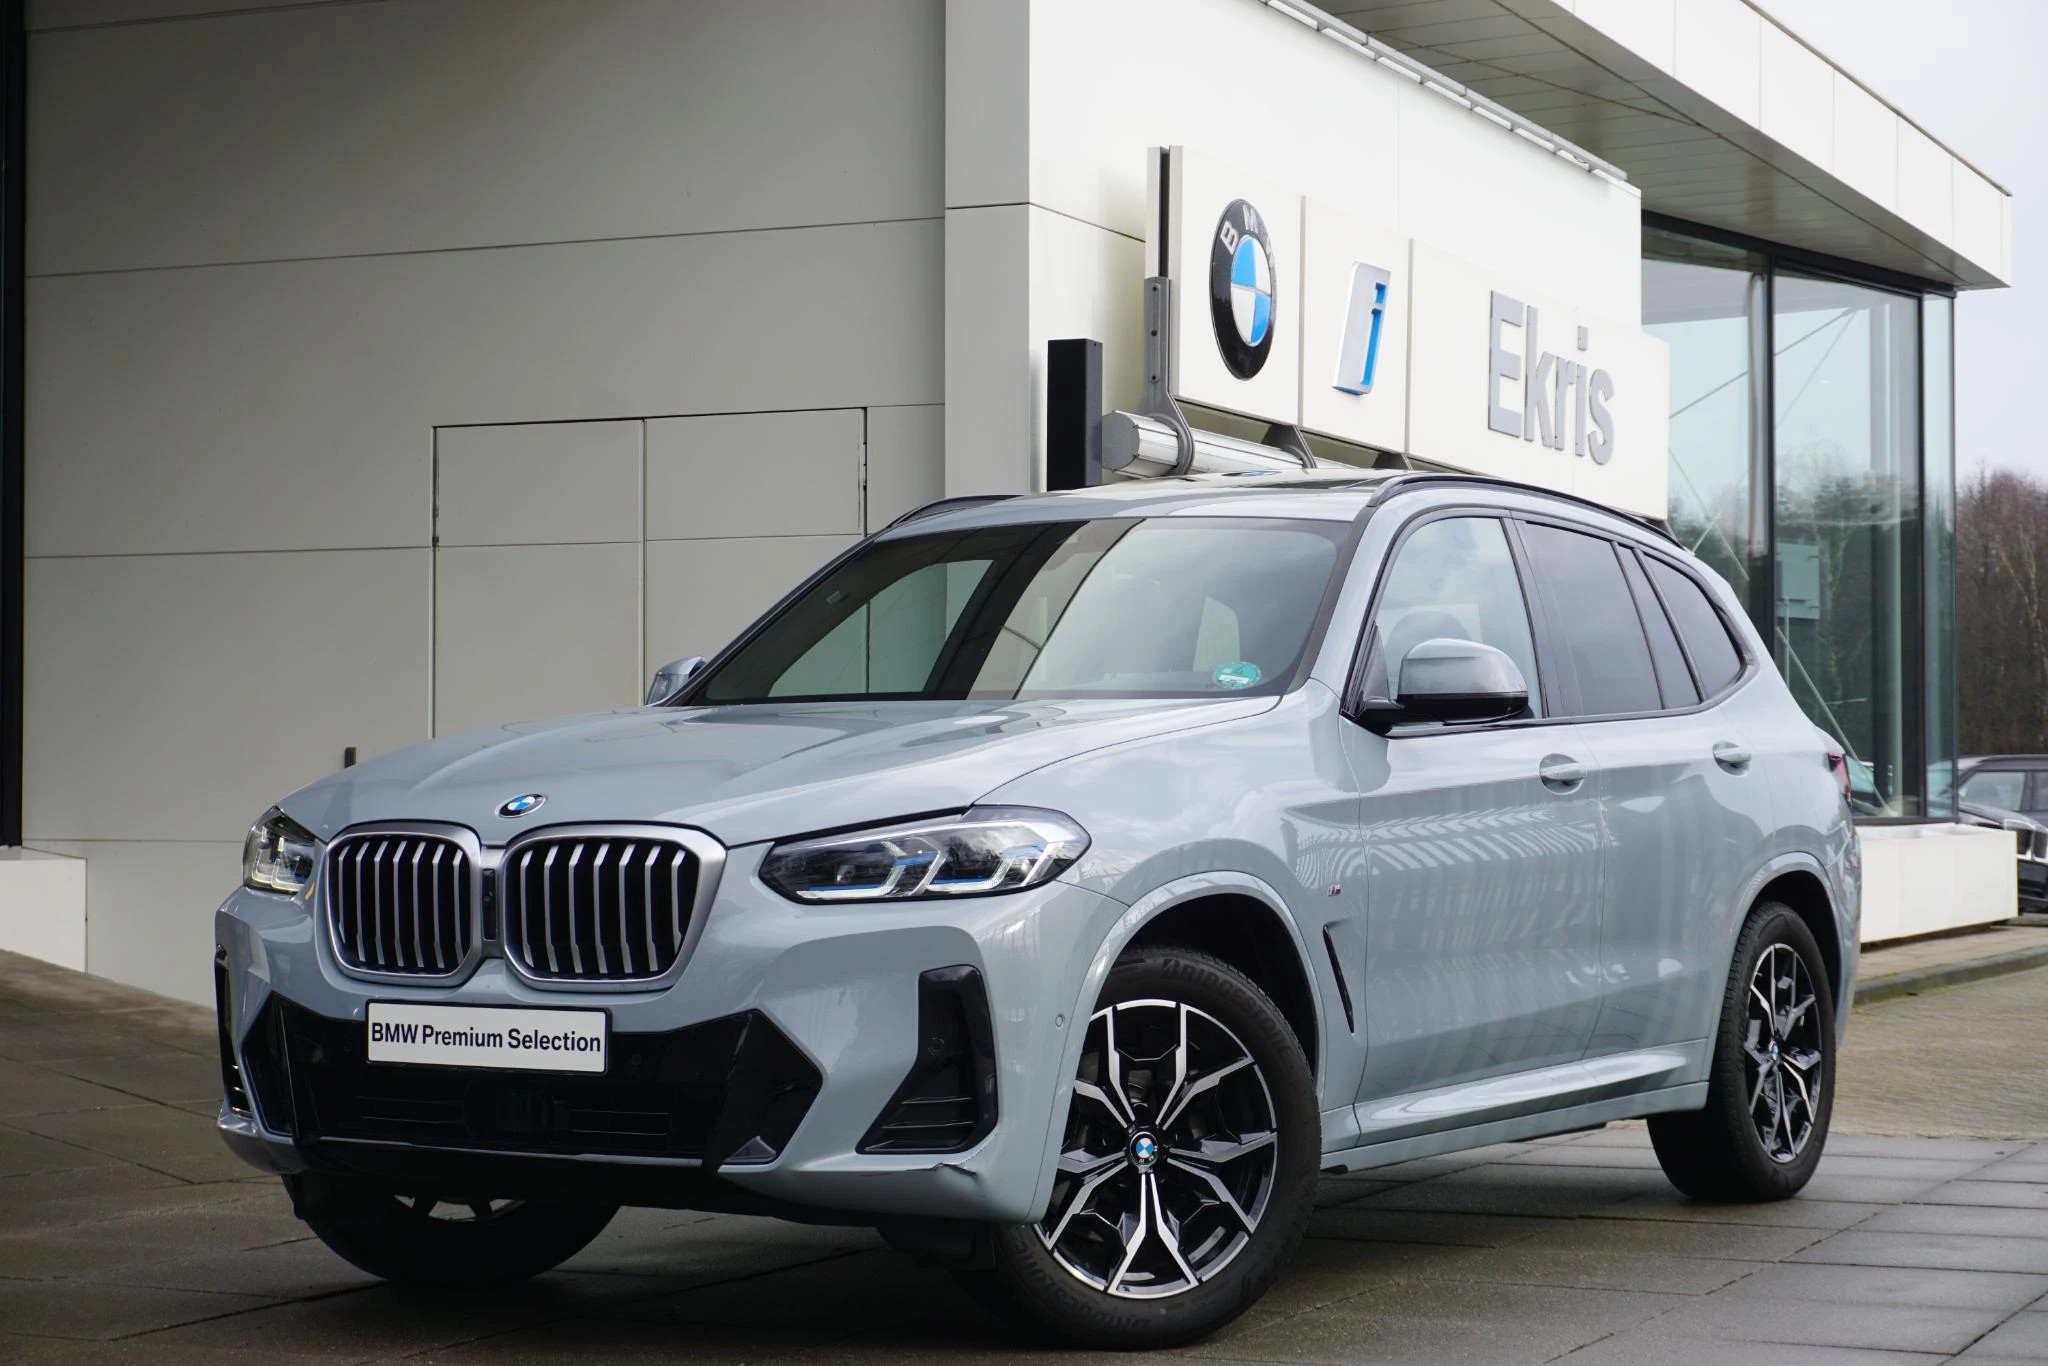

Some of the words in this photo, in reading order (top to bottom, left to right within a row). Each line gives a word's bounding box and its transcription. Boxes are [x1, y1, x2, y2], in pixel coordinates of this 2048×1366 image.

[1488, 290, 1615, 466] Ekris
[371, 1022, 419, 1044] BMW
[422, 1025, 503, 1048] Premium
[508, 1028, 601, 1052] Selection
